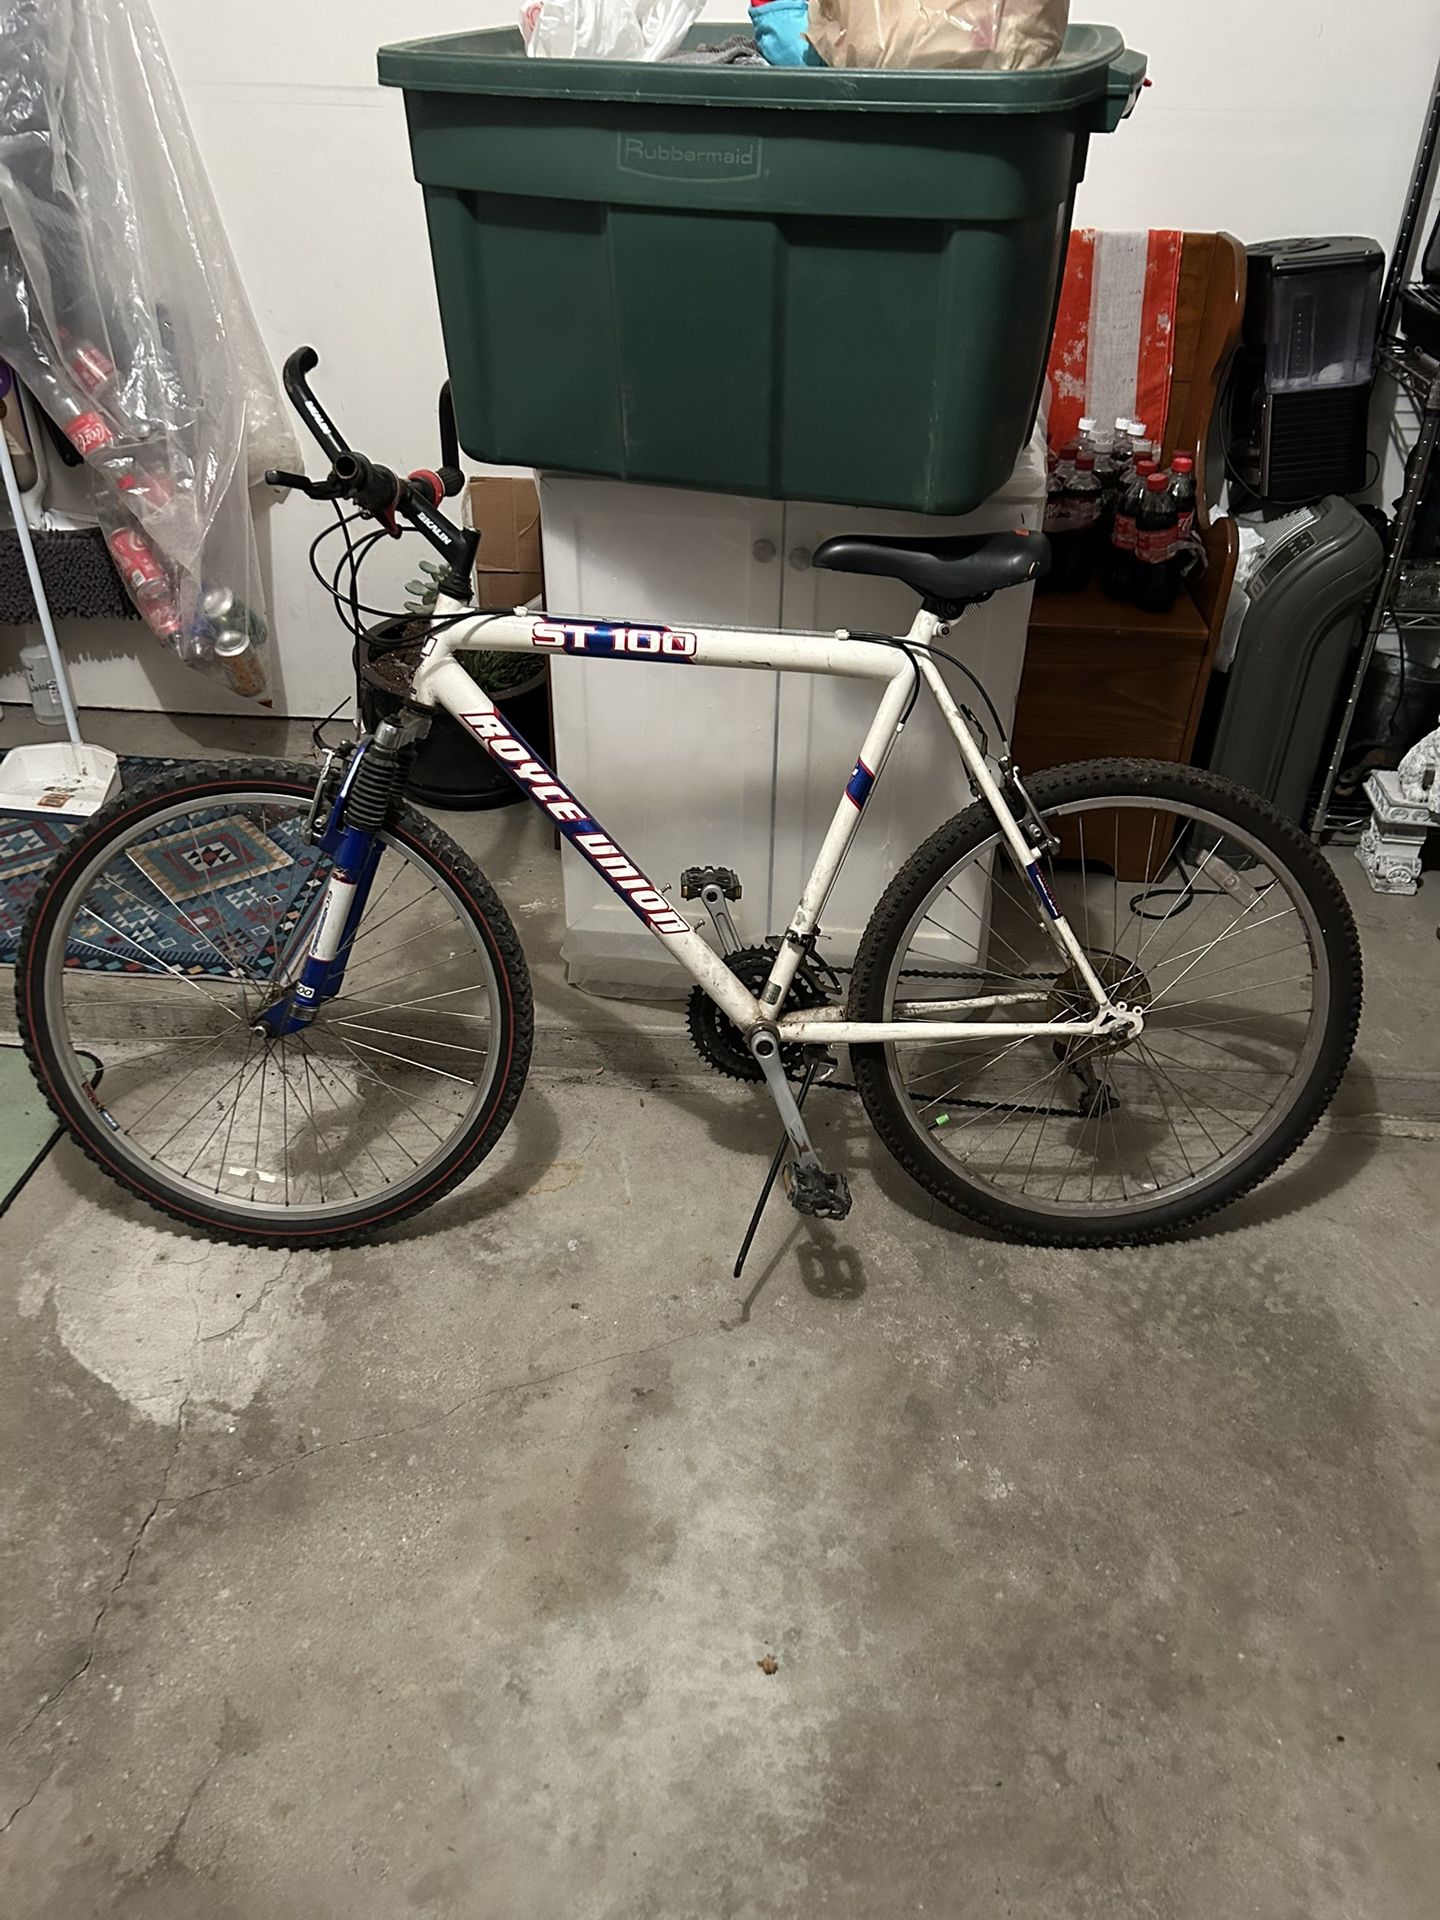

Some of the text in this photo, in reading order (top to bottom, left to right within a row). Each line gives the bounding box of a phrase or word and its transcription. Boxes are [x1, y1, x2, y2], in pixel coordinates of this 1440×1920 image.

[624, 137, 754, 165] Rubbermaid
[531, 621, 698, 657] ST 100
[459, 712, 691, 934] ROYCE UNION
